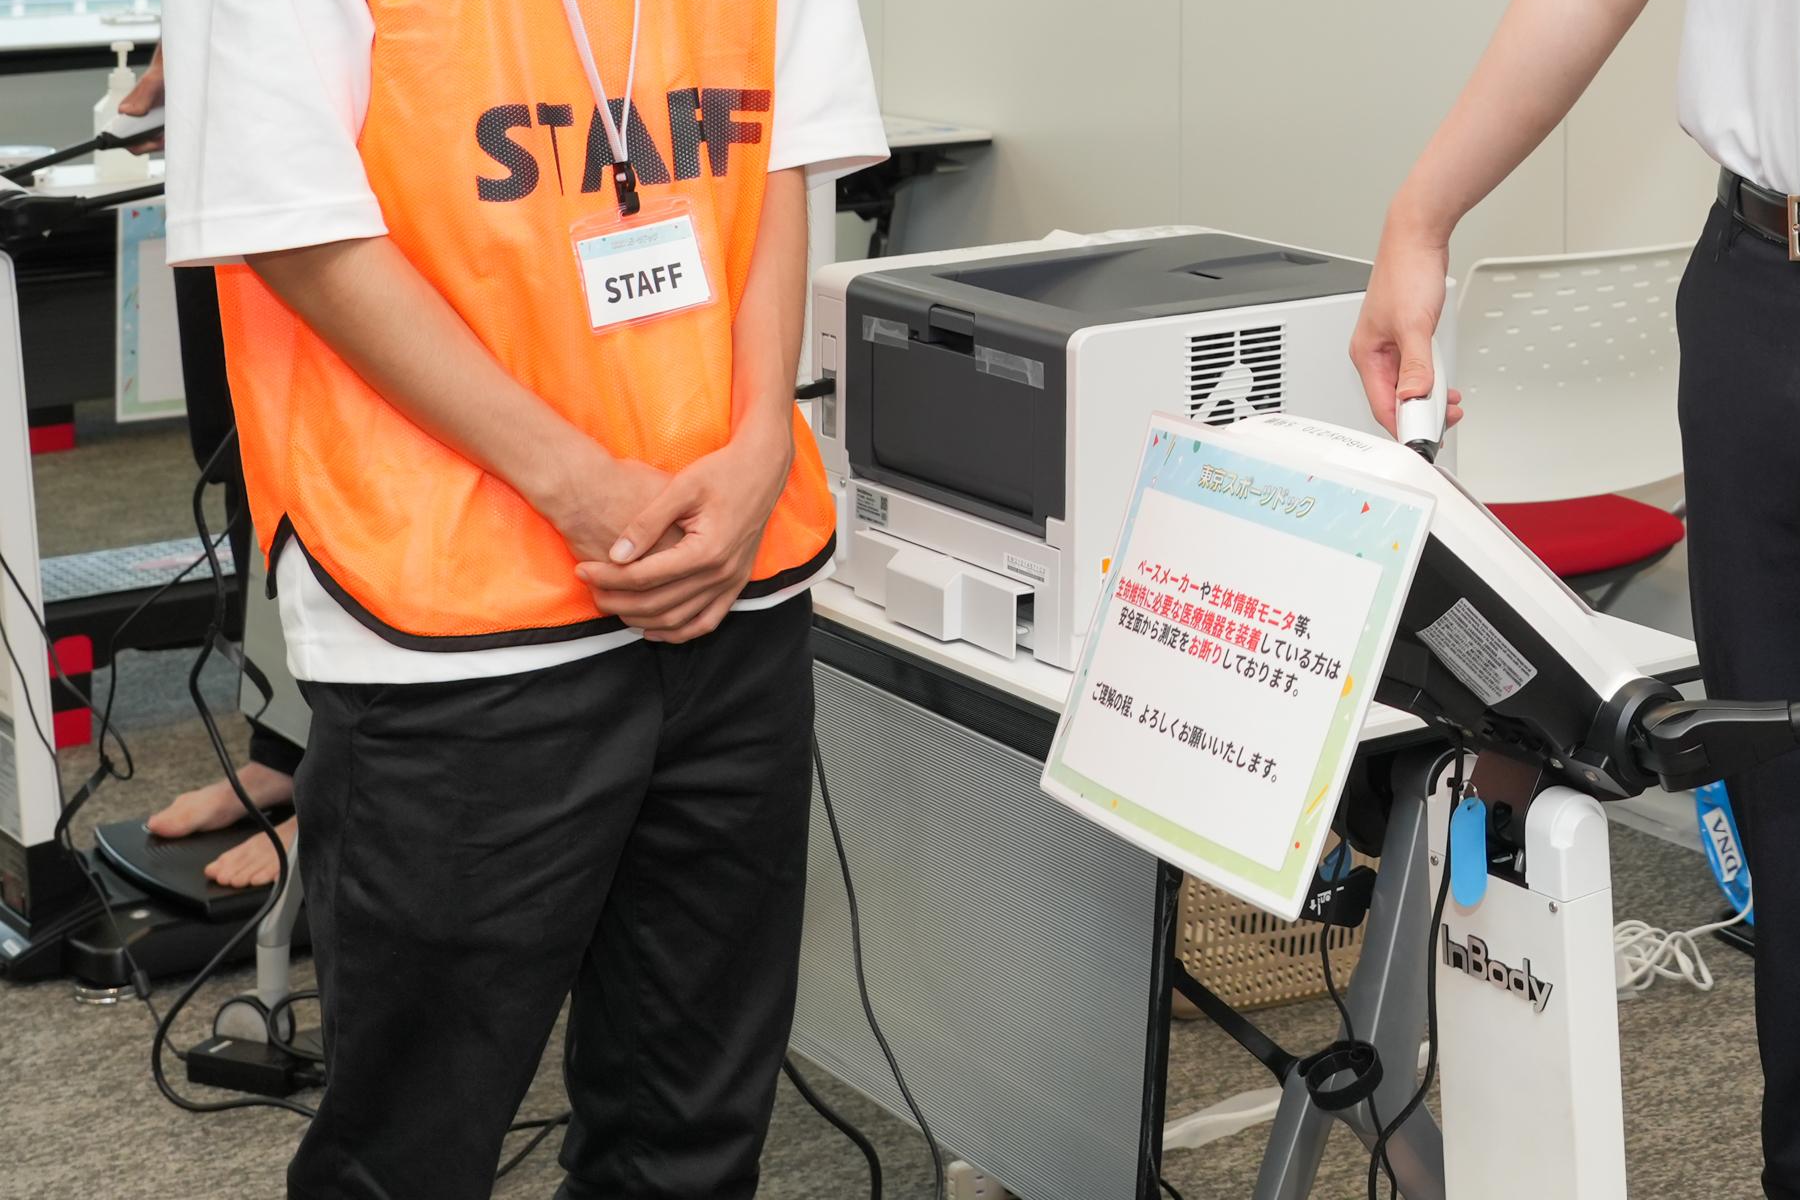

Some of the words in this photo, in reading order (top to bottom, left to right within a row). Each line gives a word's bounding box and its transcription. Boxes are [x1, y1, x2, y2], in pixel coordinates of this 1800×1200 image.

[475, 87, 772, 202] STAFF
[605, 262, 682, 304] STAFF
[1198, 464, 1315, 518] 東京スポーツドック
[1115, 577, 1341, 680] 生命維持に必要な医療機器を装着している方は
[1118, 606, 1298, 697] 安全面から測定をお断りしております。
[1441, 923, 1553, 1013] InBody
